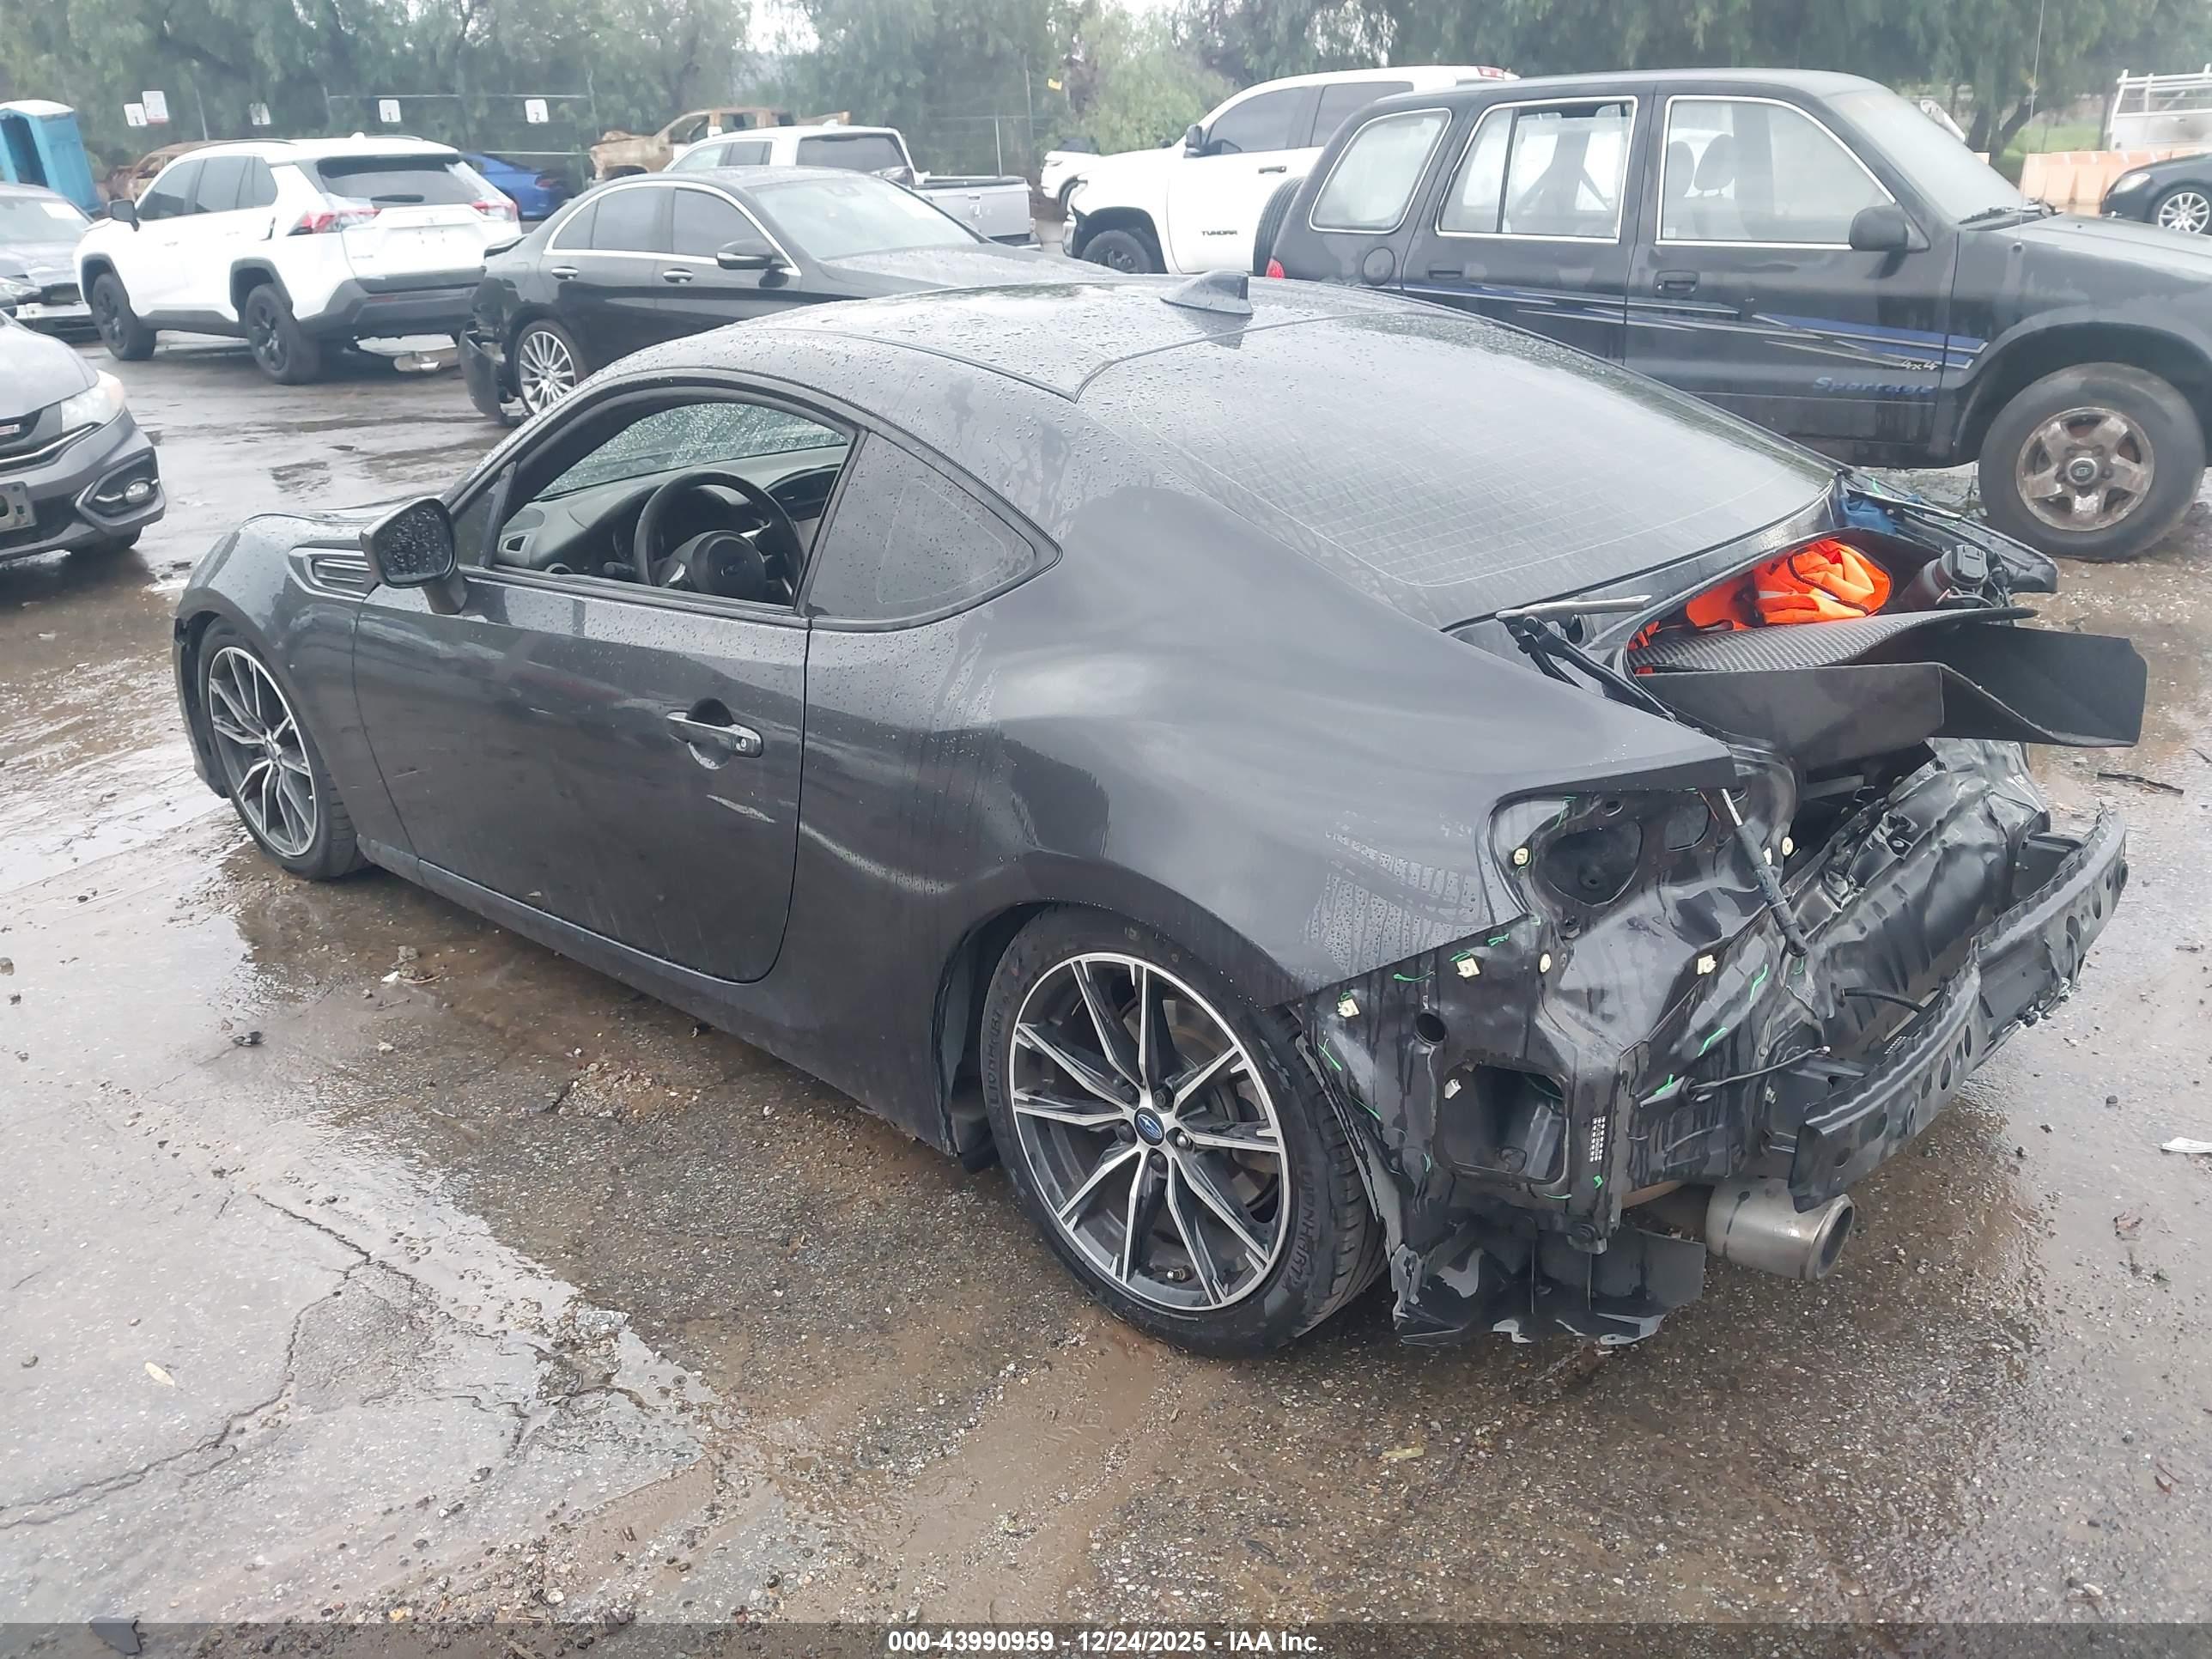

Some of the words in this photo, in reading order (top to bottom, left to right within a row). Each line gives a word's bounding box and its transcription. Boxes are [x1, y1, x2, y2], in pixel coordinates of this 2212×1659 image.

[533, 112, 541, 121] 2
[1900, 358, 1938, 371] 4x4
[1813, 376, 1936, 395] Sportage
